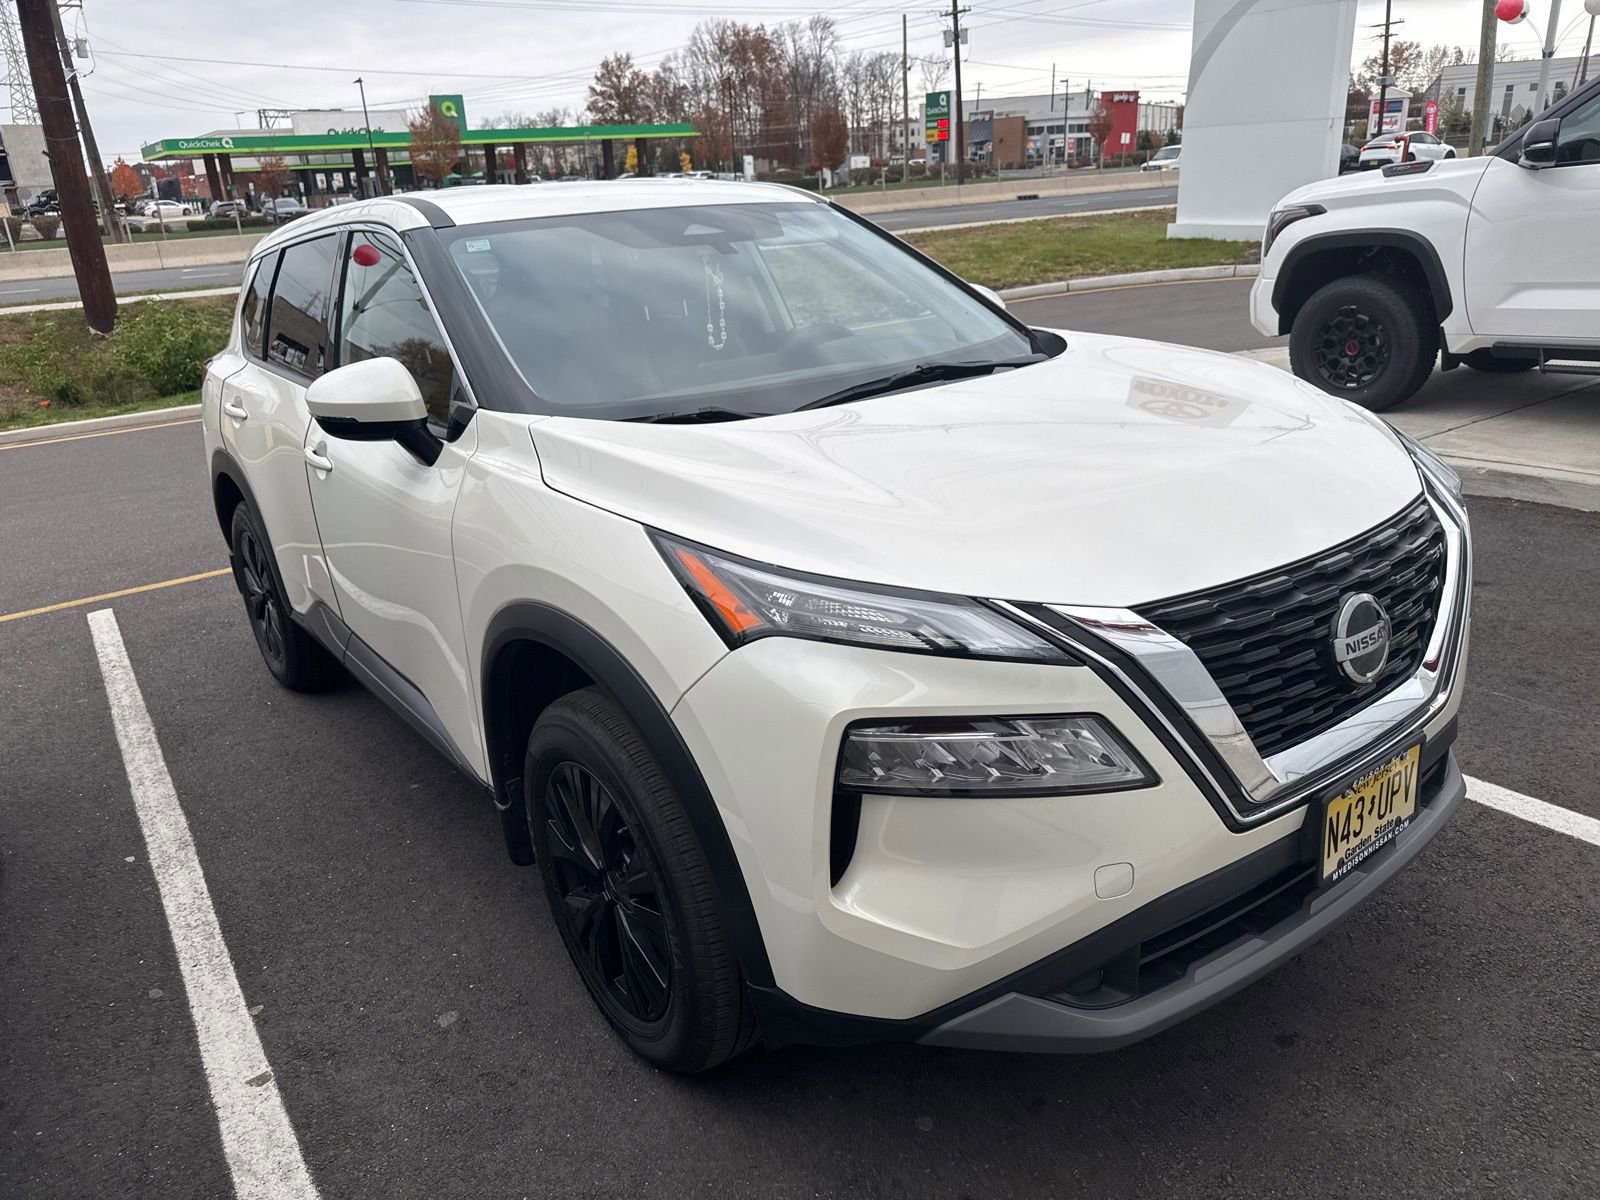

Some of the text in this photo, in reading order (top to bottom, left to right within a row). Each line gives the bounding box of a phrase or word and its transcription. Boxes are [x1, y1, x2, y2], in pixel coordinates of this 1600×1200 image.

[179, 140, 221, 149] QuickChek
[1345, 622, 1388, 656] NISSAN
[1332, 820, 1410, 881] MYEDISONNISSAN.COM
[1344, 818, 1395, 860] Garden State
